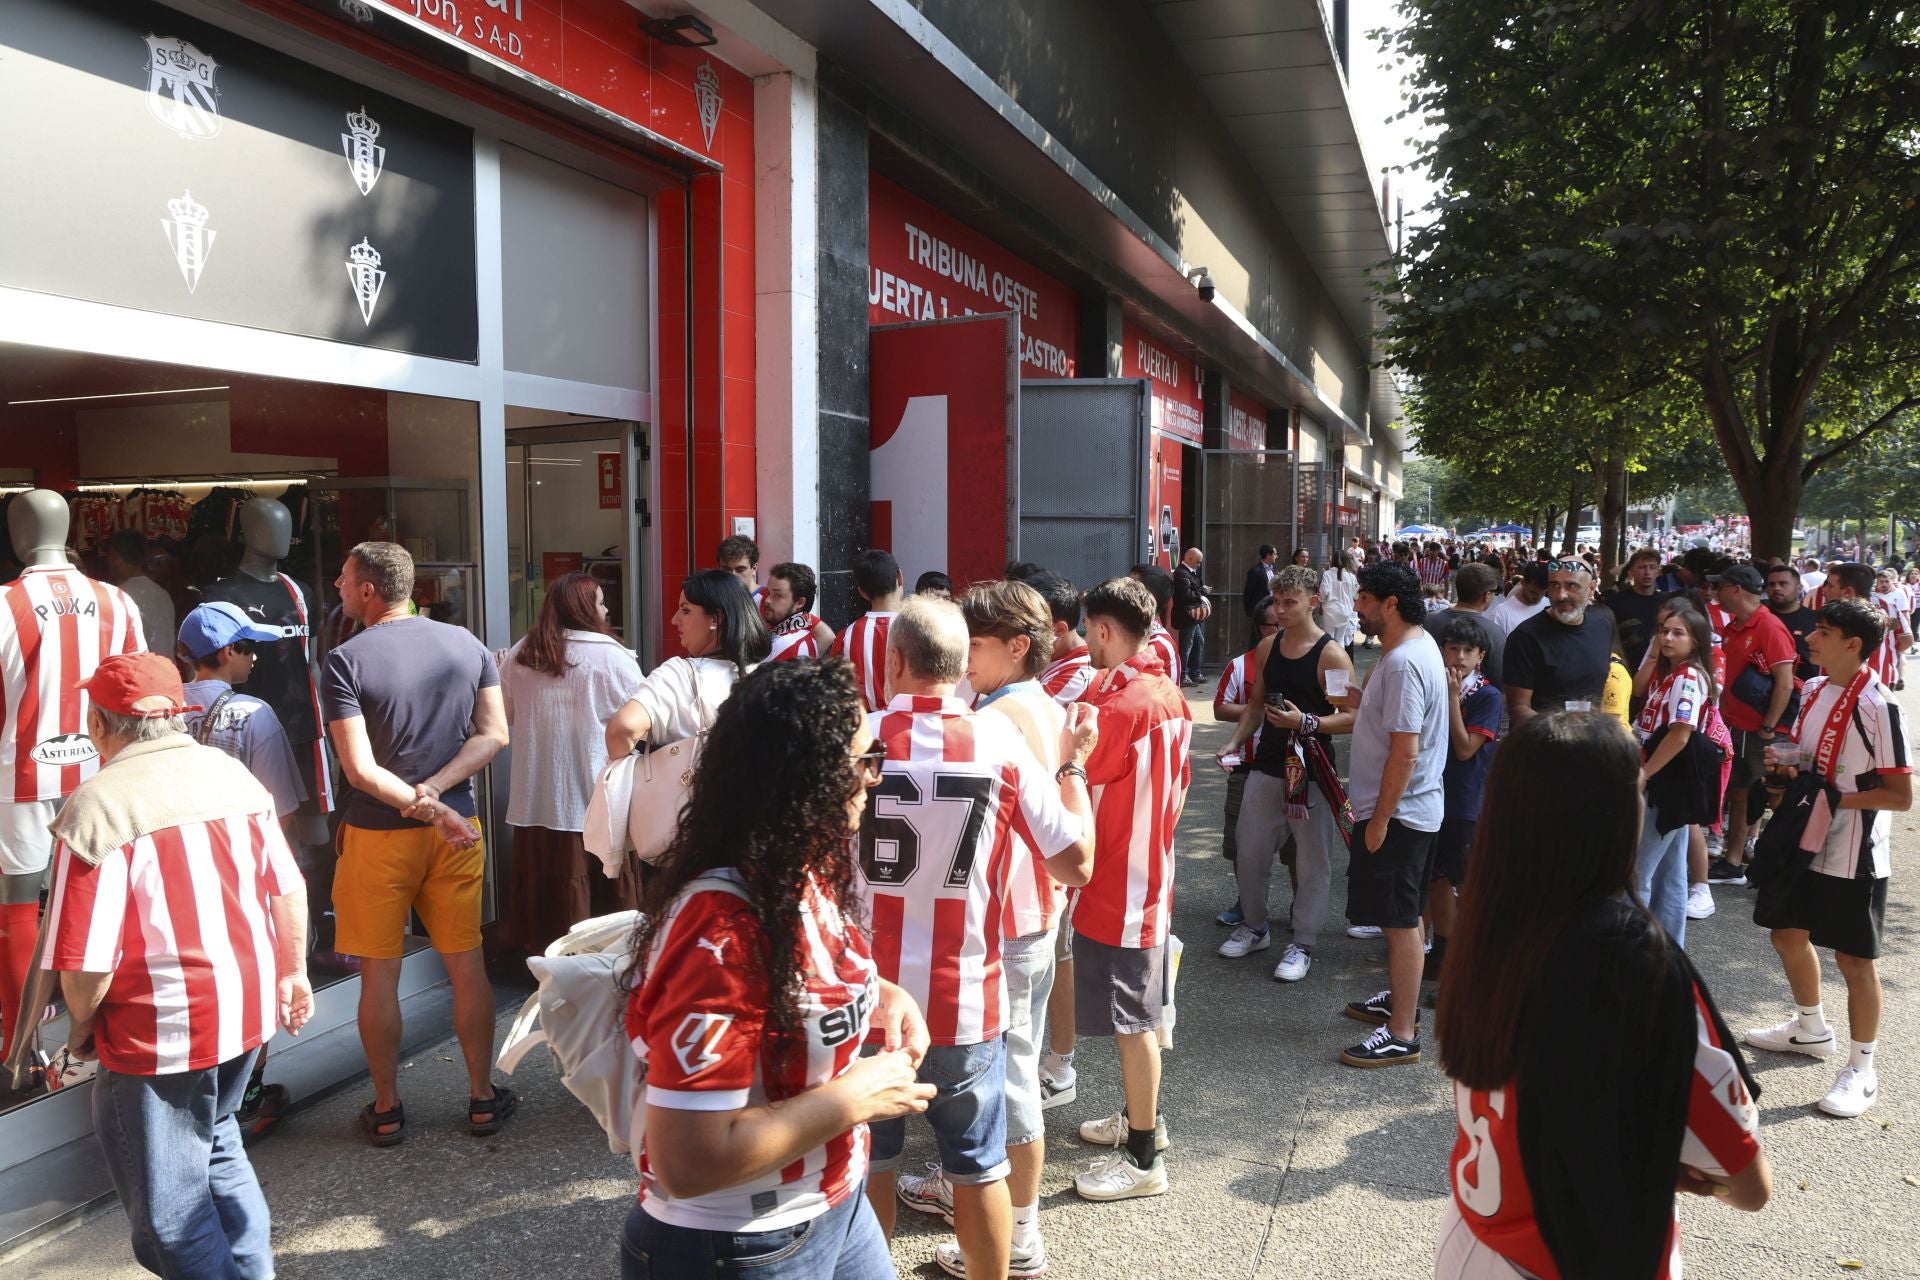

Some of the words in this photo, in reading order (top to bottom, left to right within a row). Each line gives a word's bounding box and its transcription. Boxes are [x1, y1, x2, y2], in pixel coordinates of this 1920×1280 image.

[868, 265, 935, 320] UERTA
[904, 222, 989, 297] TRIBUNA
[992, 271, 1038, 320] OESTE
[1138, 339, 1171, 385] PUERTA
[602, 495, 621, 505] EXTINT
[870, 394, 948, 590] 1
[33, 597, 97, 622] PUXA
[205, 695, 229, 728] Reebok
[1817, 727, 1838, 775] UIEN
[857, 770, 996, 889] 67
